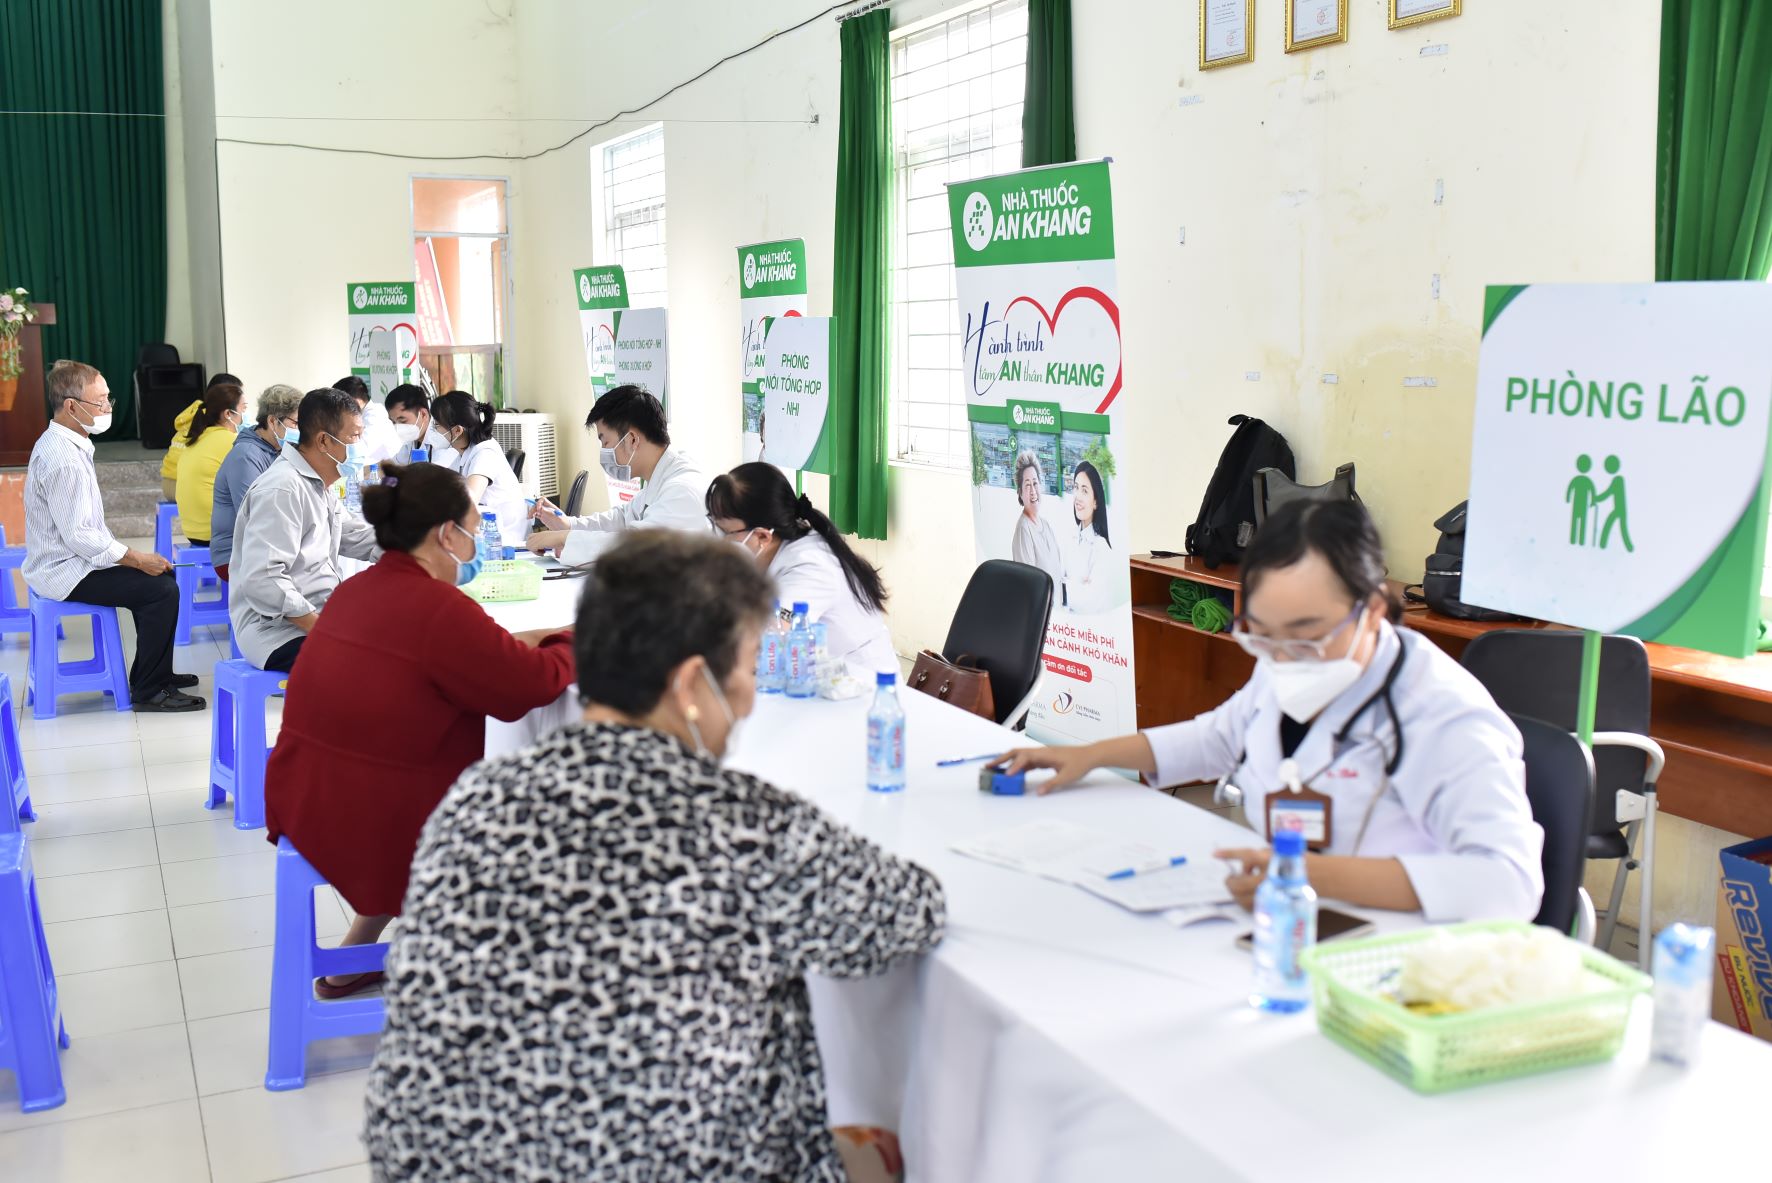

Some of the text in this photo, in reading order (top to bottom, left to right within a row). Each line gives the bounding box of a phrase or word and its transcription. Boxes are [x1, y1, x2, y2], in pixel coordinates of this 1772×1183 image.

[1001, 180, 1079, 212] NHÀ THUỐC
[993, 206, 1092, 241] AN KHANG
[755, 262, 797, 283] AN KHANG
[367, 294, 408, 306] AN KHANG
[999, 360, 1022, 382] AN
[1045, 362, 1105, 387] KHANG
[786, 401, 800, 417] NHI
[1505, 370, 1746, 427] PHÒNG LÃO
